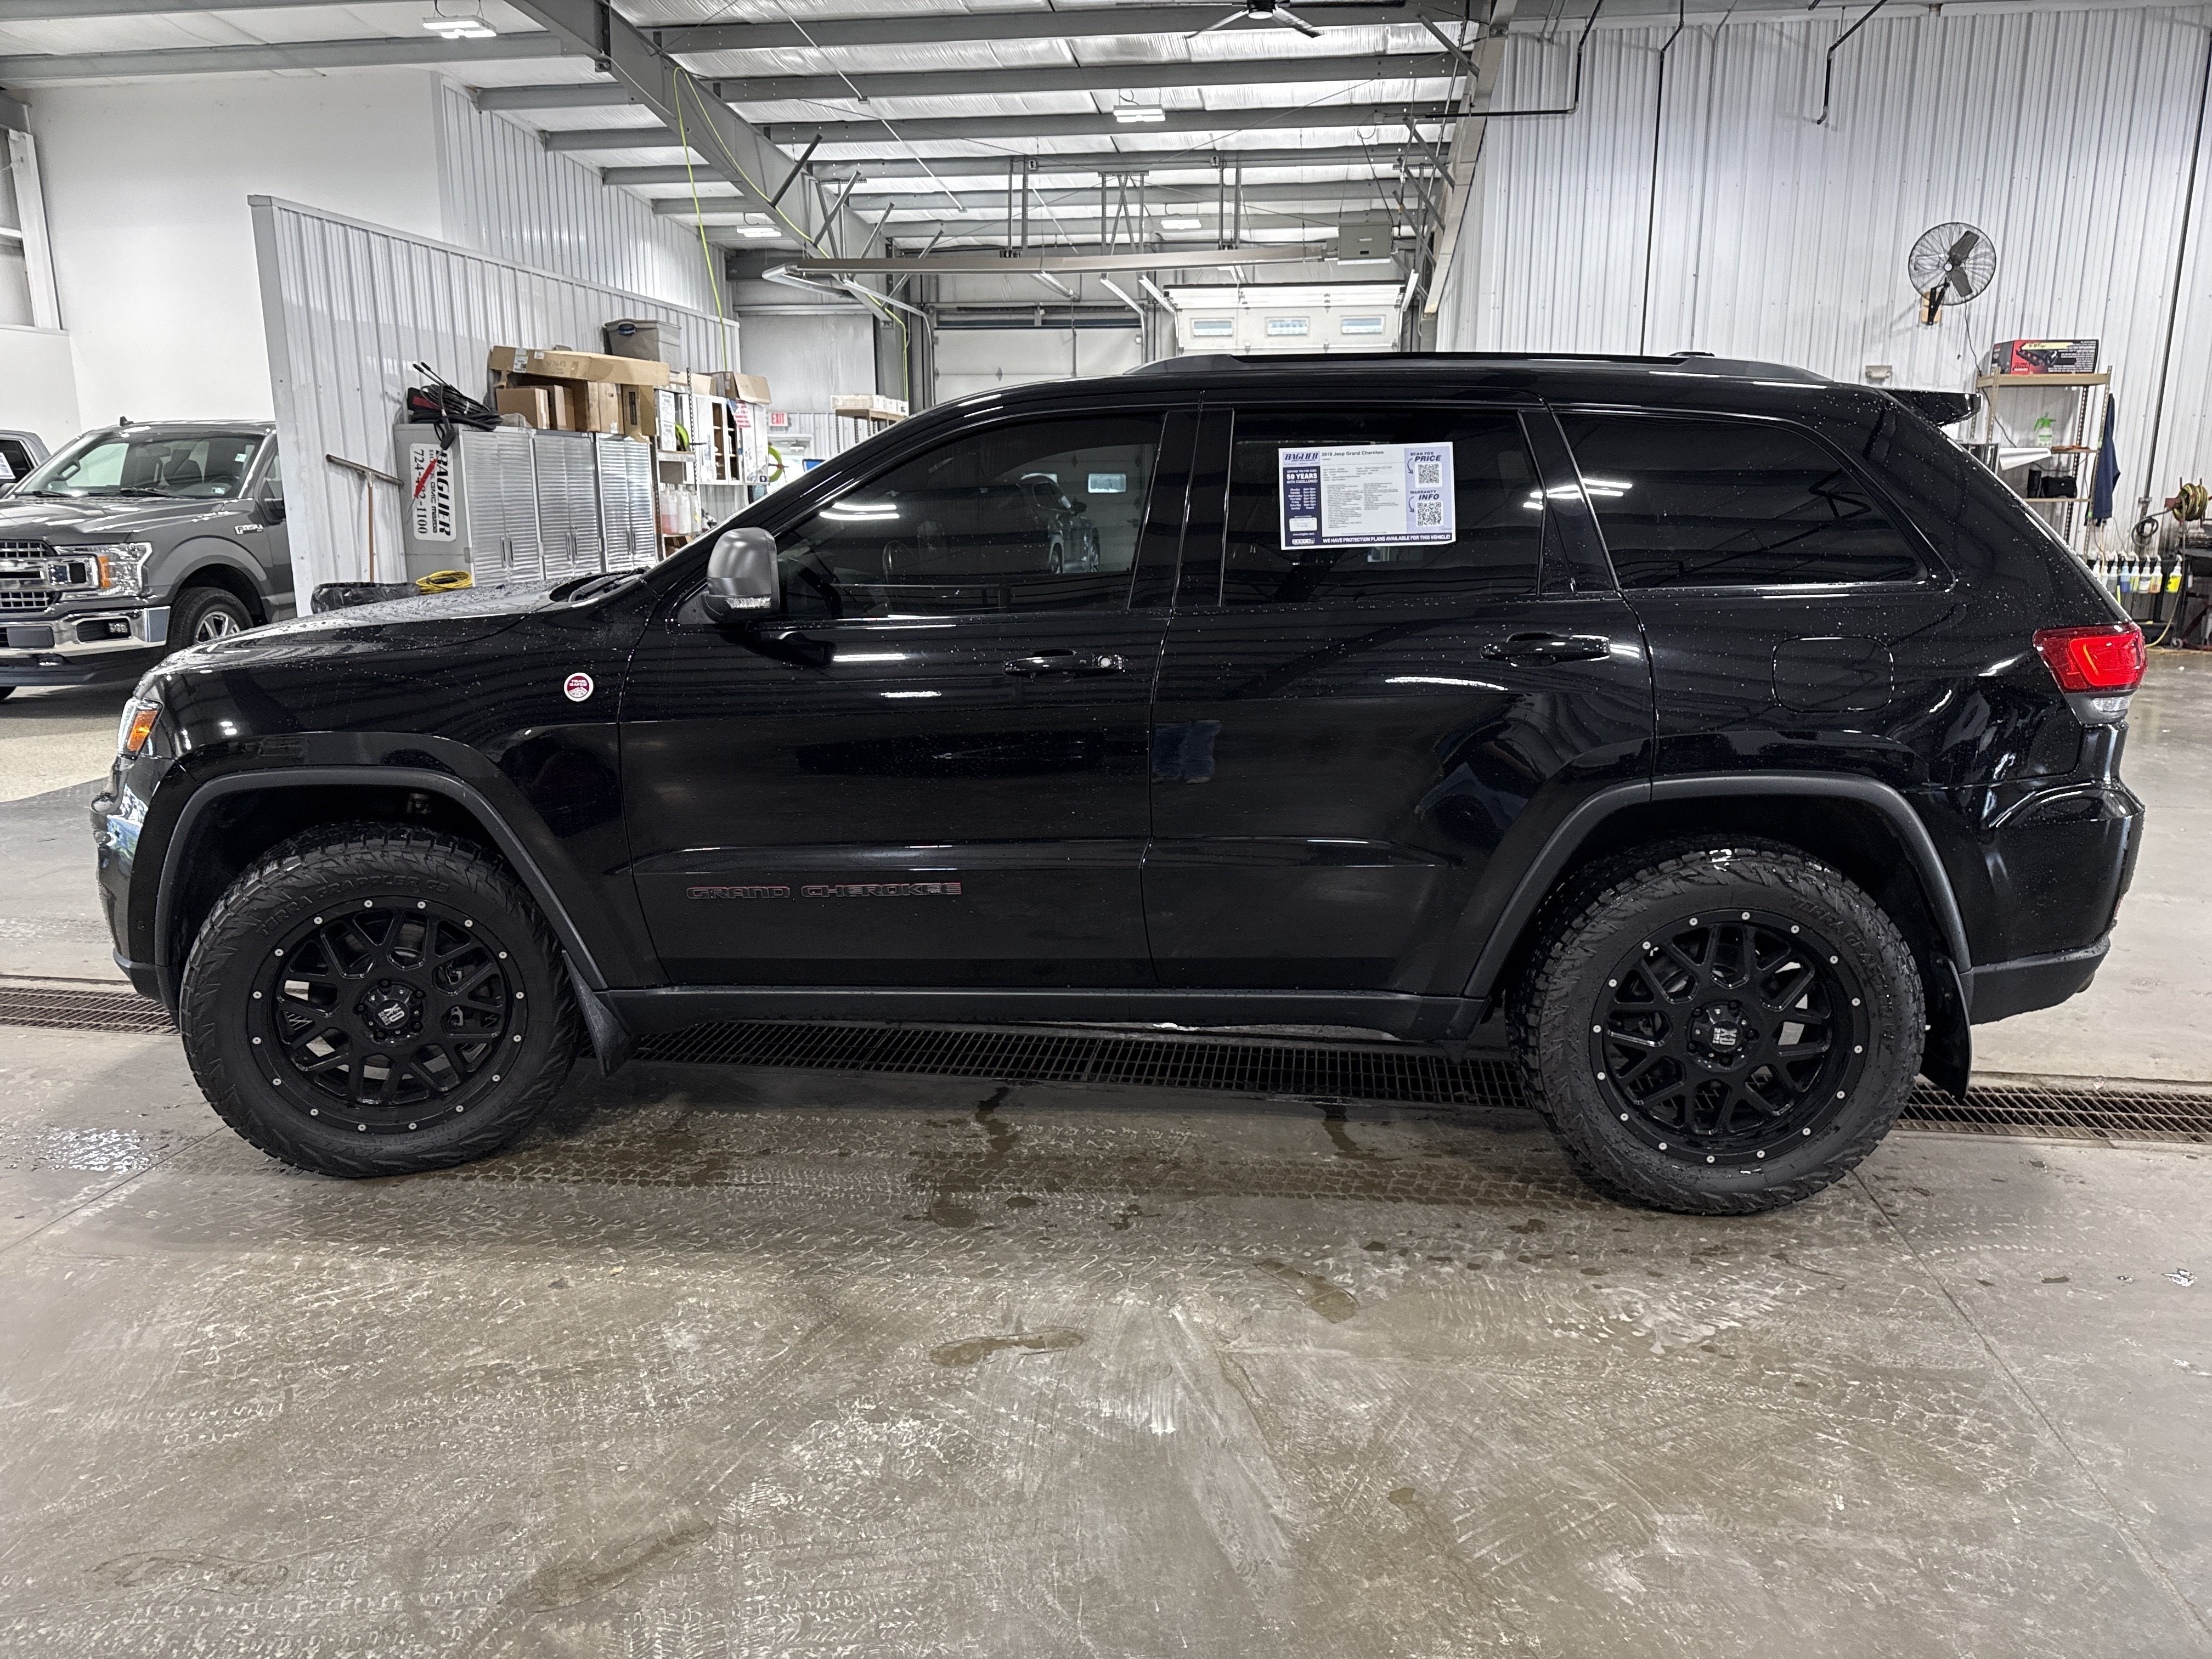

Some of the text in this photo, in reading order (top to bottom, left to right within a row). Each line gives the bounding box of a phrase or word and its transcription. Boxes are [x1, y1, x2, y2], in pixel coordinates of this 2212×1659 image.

[771, 413, 785, 424] EXIT
[436, 450, 451, 536] BAGLIER
[686, 882, 962, 899] GRAND CHEROKEE
[255, 895, 314, 936] TERRA
[314, 876, 420, 899] GRAPPLER
[383, 1003, 405, 1022] XD
[1719, 1028, 1737, 1045] XD
